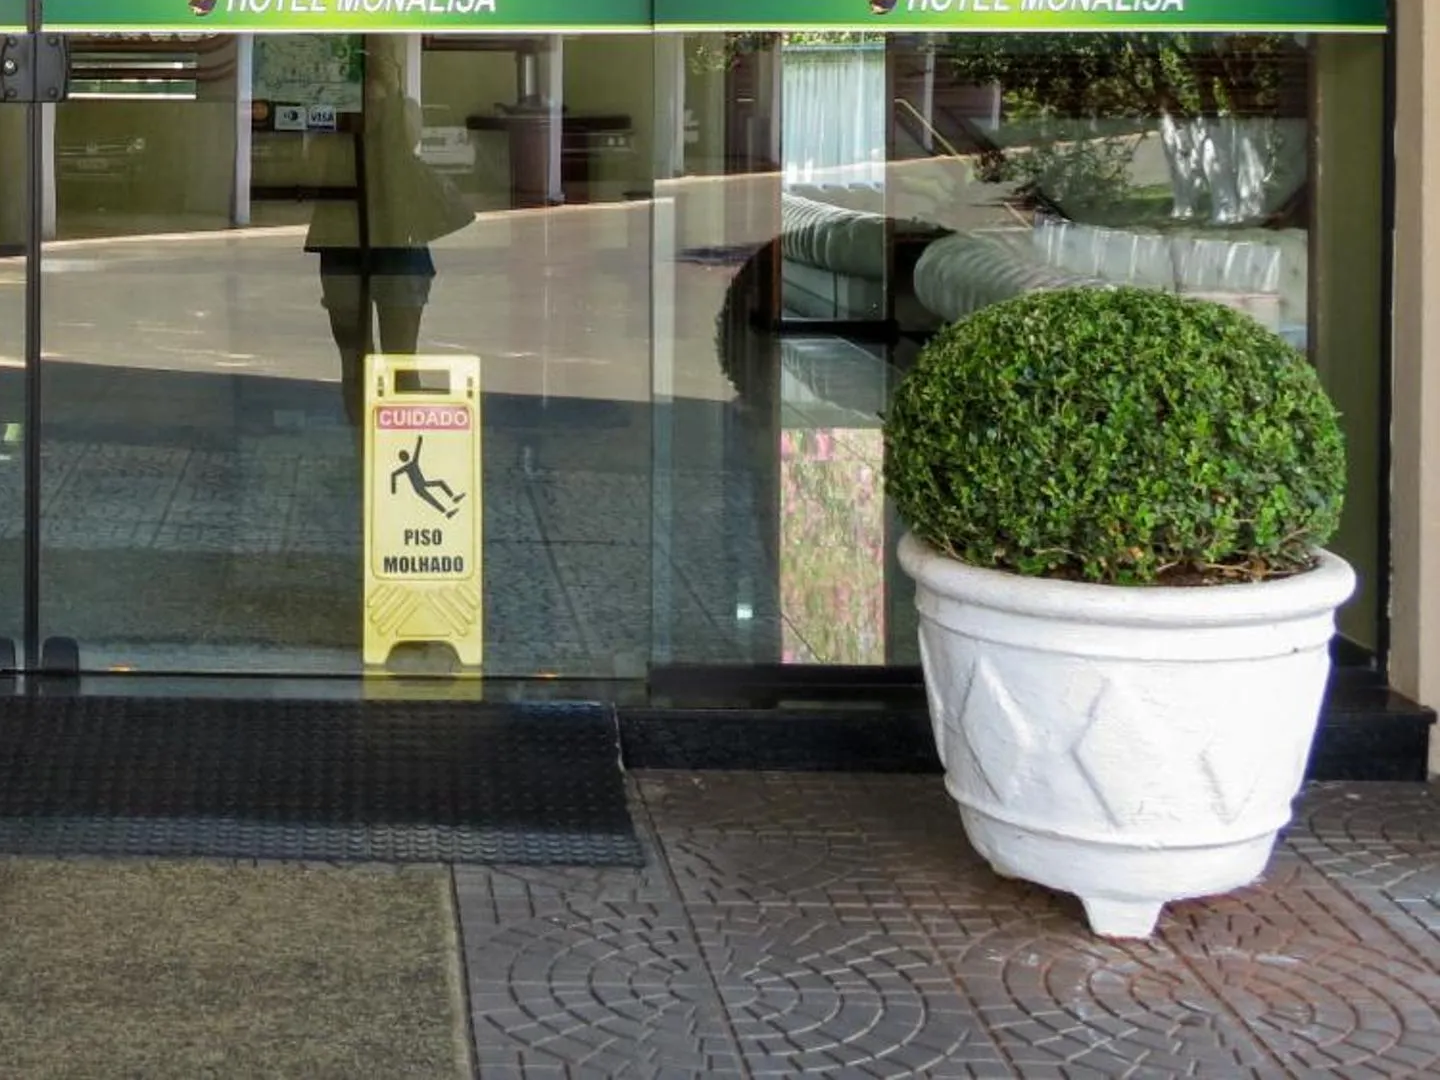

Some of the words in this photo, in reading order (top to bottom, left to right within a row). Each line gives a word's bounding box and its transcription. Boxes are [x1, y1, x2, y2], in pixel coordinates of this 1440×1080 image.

[310, 111, 334, 122] VISA
[378, 409, 469, 427] CUIDADO
[403, 528, 443, 546] PISO
[382, 556, 465, 574] MOLHADO
